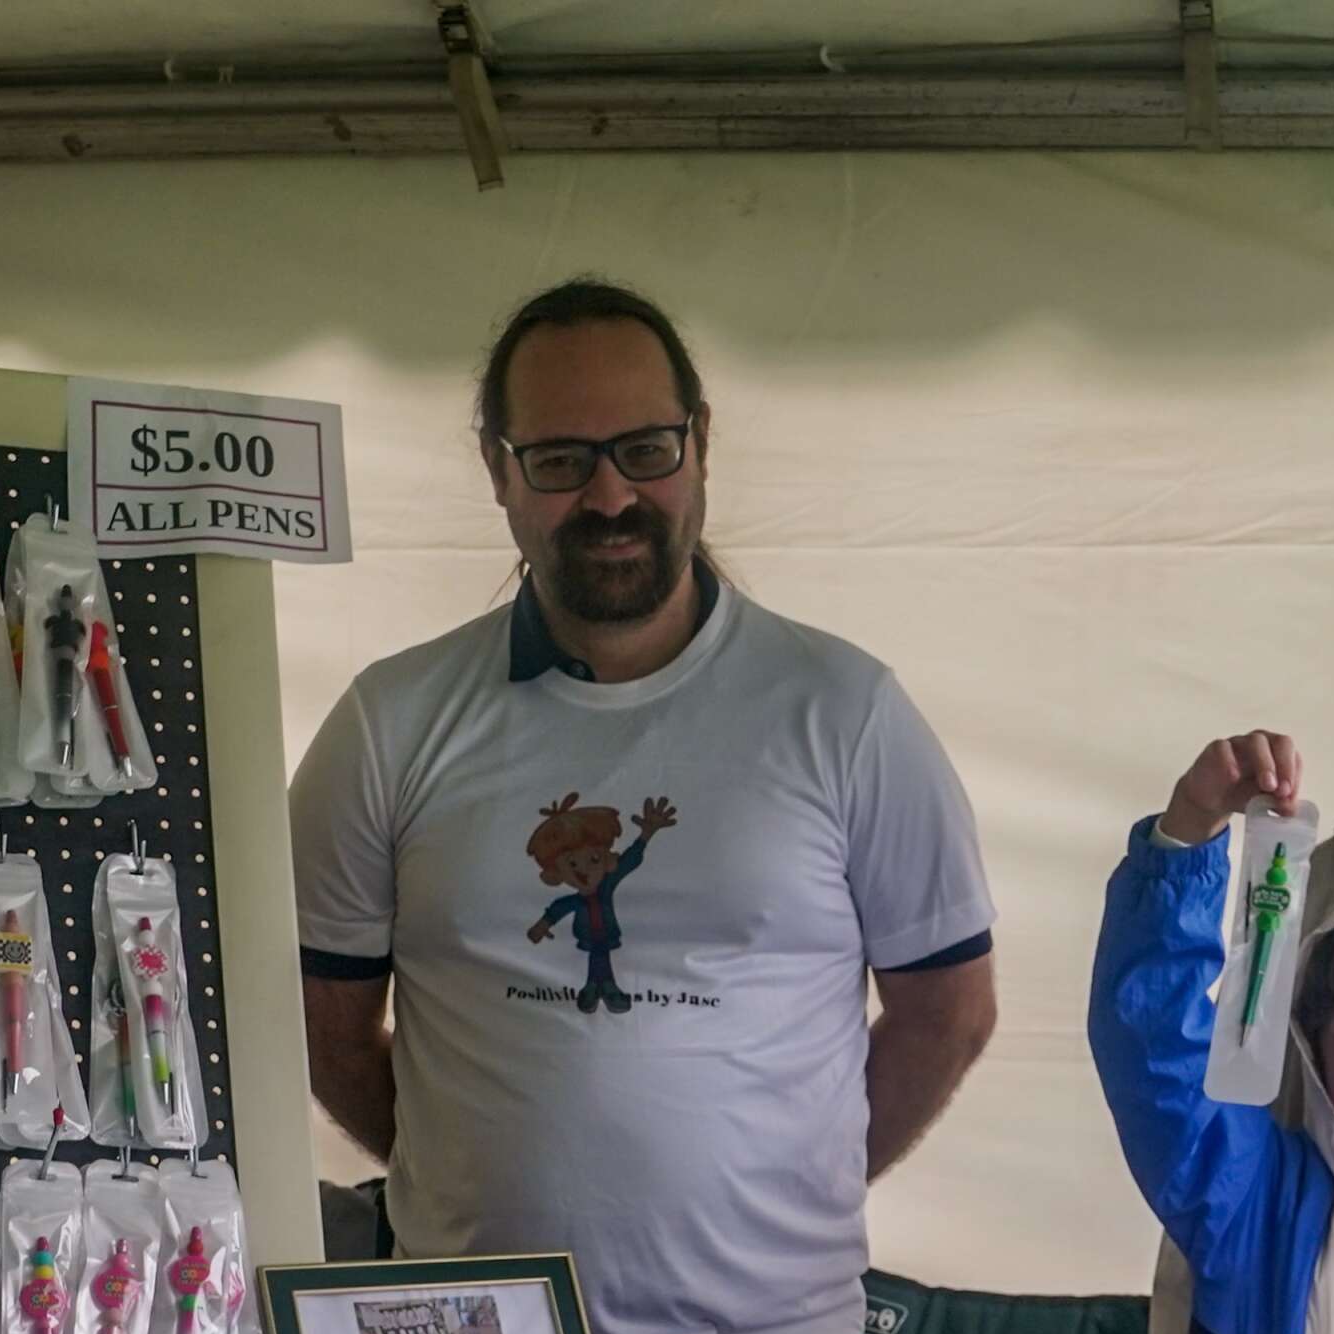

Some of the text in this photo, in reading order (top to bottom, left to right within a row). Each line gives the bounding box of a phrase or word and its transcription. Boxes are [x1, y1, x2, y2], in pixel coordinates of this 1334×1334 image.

[130, 424, 274, 477] $5.00
[106, 500, 316, 539] ALL PENS
[506, 986, 577, 1001] Positivit
[647, 989, 672, 1007] by
[677, 991, 721, 1008] Jase
